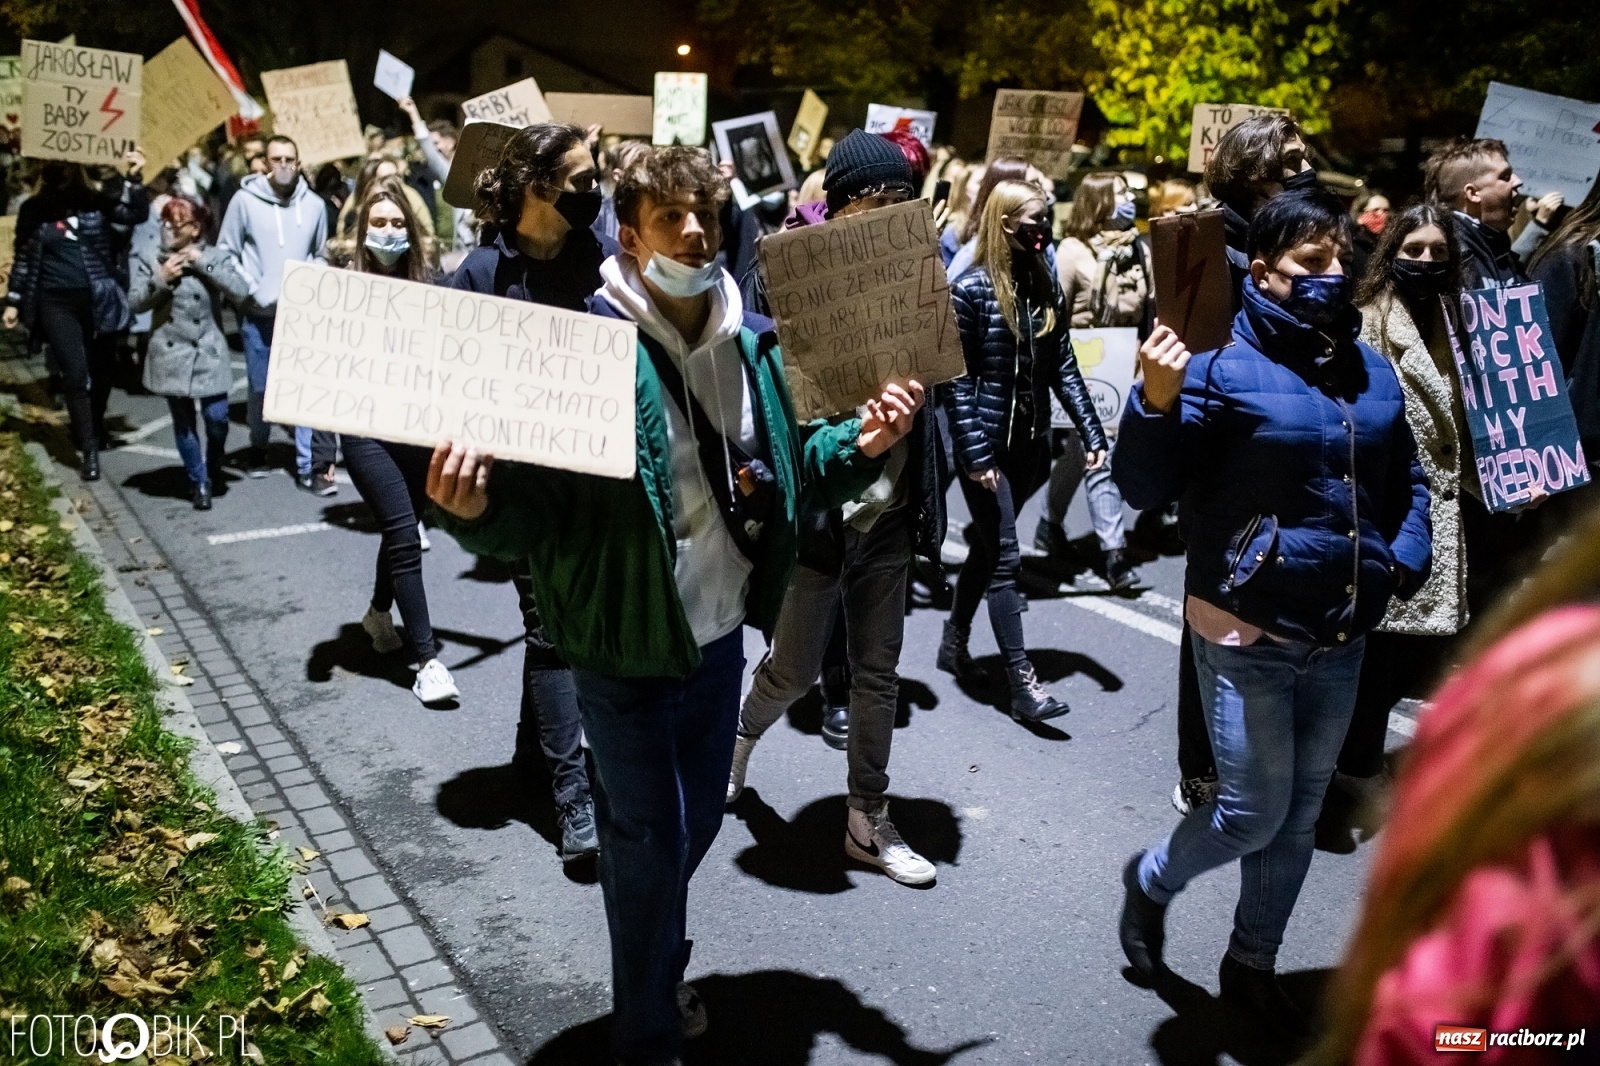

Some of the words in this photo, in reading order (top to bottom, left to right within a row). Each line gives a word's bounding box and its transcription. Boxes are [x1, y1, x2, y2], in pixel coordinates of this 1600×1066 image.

[27, 43, 132, 83] JAROSŁAW
[43, 103, 90, 127] BABY
[63, 85, 87, 104] TY
[1209, 109, 1232, 124] TO
[764, 209, 930, 286] MORAWIECKI
[807, 281, 838, 310] NIC
[874, 258, 915, 288] MASZ
[549, 316, 583, 352] NIE
[593, 325, 629, 361] DO
[779, 303, 858, 349] OKULARY
[876, 290, 909, 317] TAK
[828, 311, 934, 357] DOSTANIESZ
[282, 307, 365, 348] RYMU
[383, 326, 425, 358] NIE
[440, 334, 481, 367] DO
[501, 343, 600, 386] TAKTU
[276, 342, 452, 396] PRZYKLEIMY
[462, 376, 501, 405] CIĘ
[515, 383, 619, 423] SZMATO
[1460, 361, 1558, 410] WITH
[403, 403, 443, 434] DO
[462, 410, 606, 458] KONTAKTU
[1484, 407, 1527, 450] MY
[1476, 440, 1590, 513] FREEDOM
